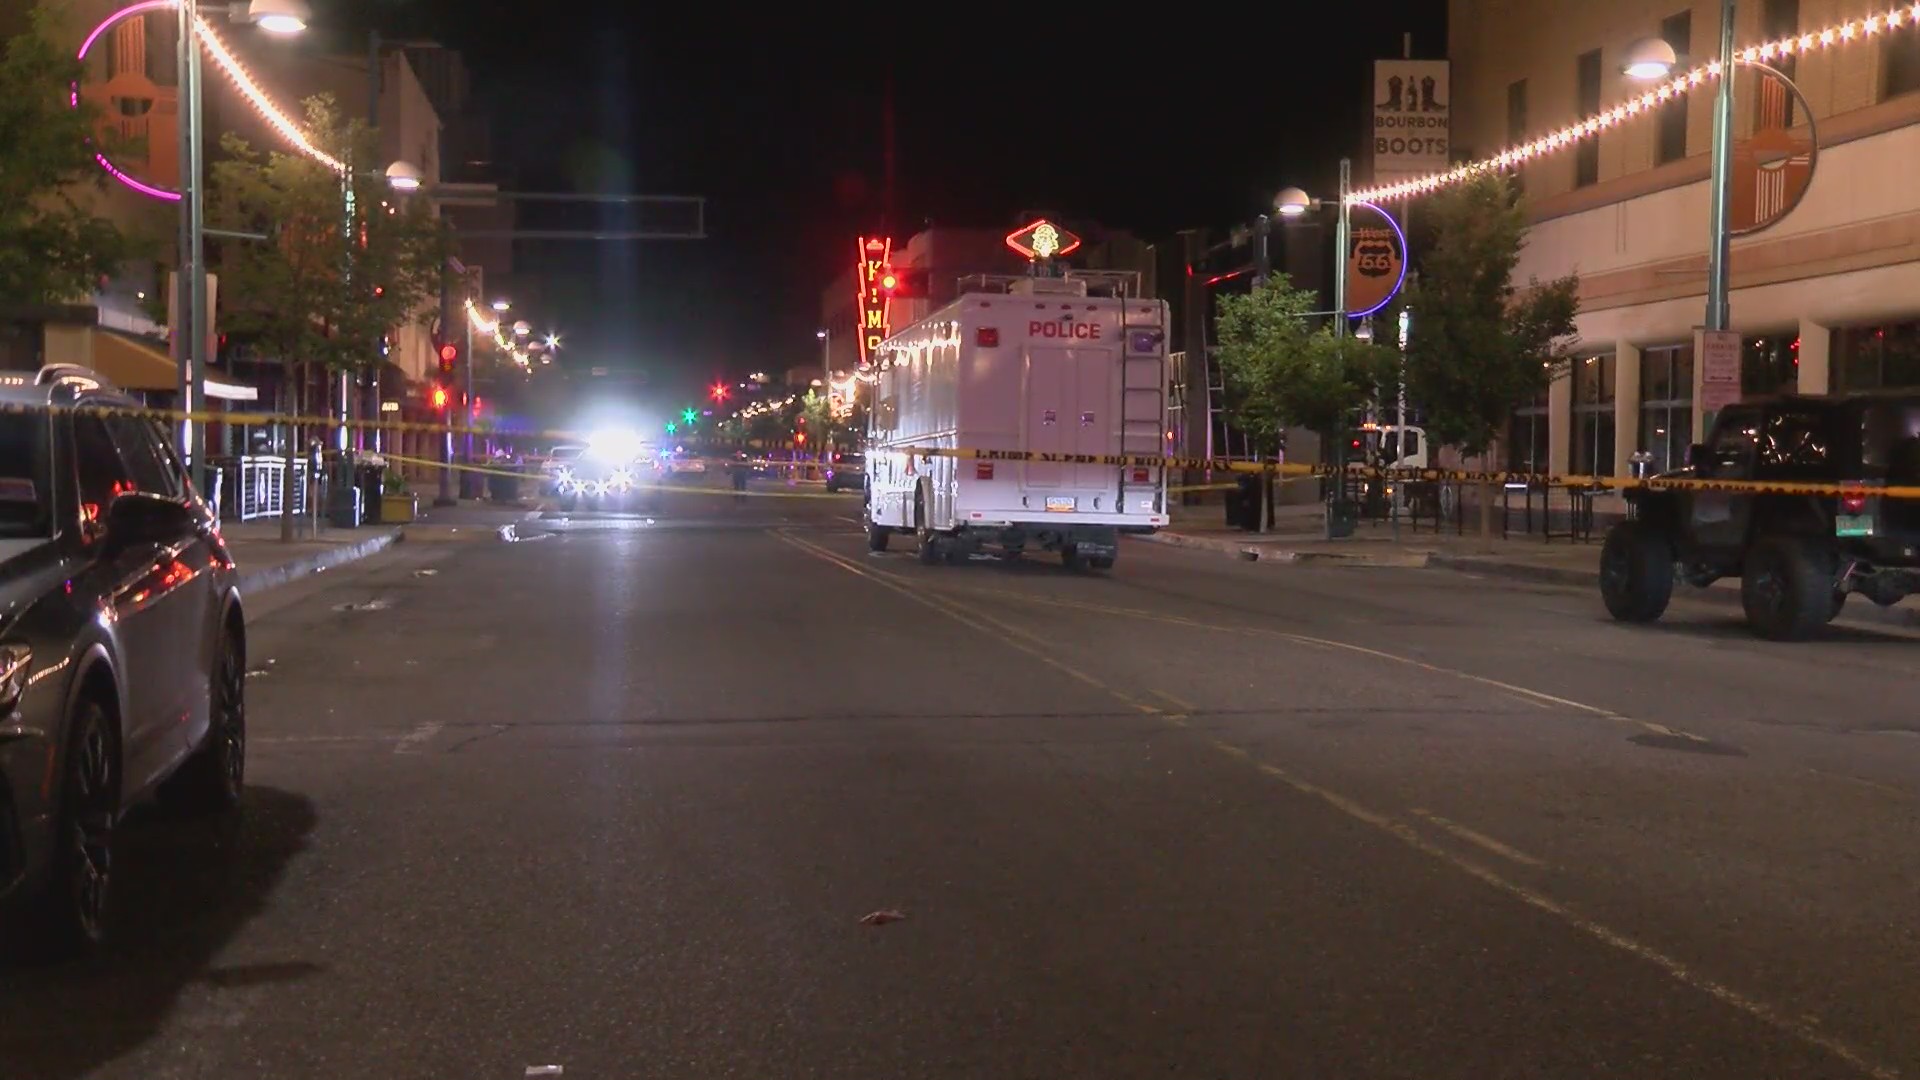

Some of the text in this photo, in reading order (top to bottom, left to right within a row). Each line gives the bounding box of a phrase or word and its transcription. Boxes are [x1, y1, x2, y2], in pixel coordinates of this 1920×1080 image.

[1376, 115, 1448, 128] BOURBON
[1376, 137, 1447, 154] BOOTS
[1361, 252, 1389, 270] 66
[1029, 320, 1101, 339] POLICE
